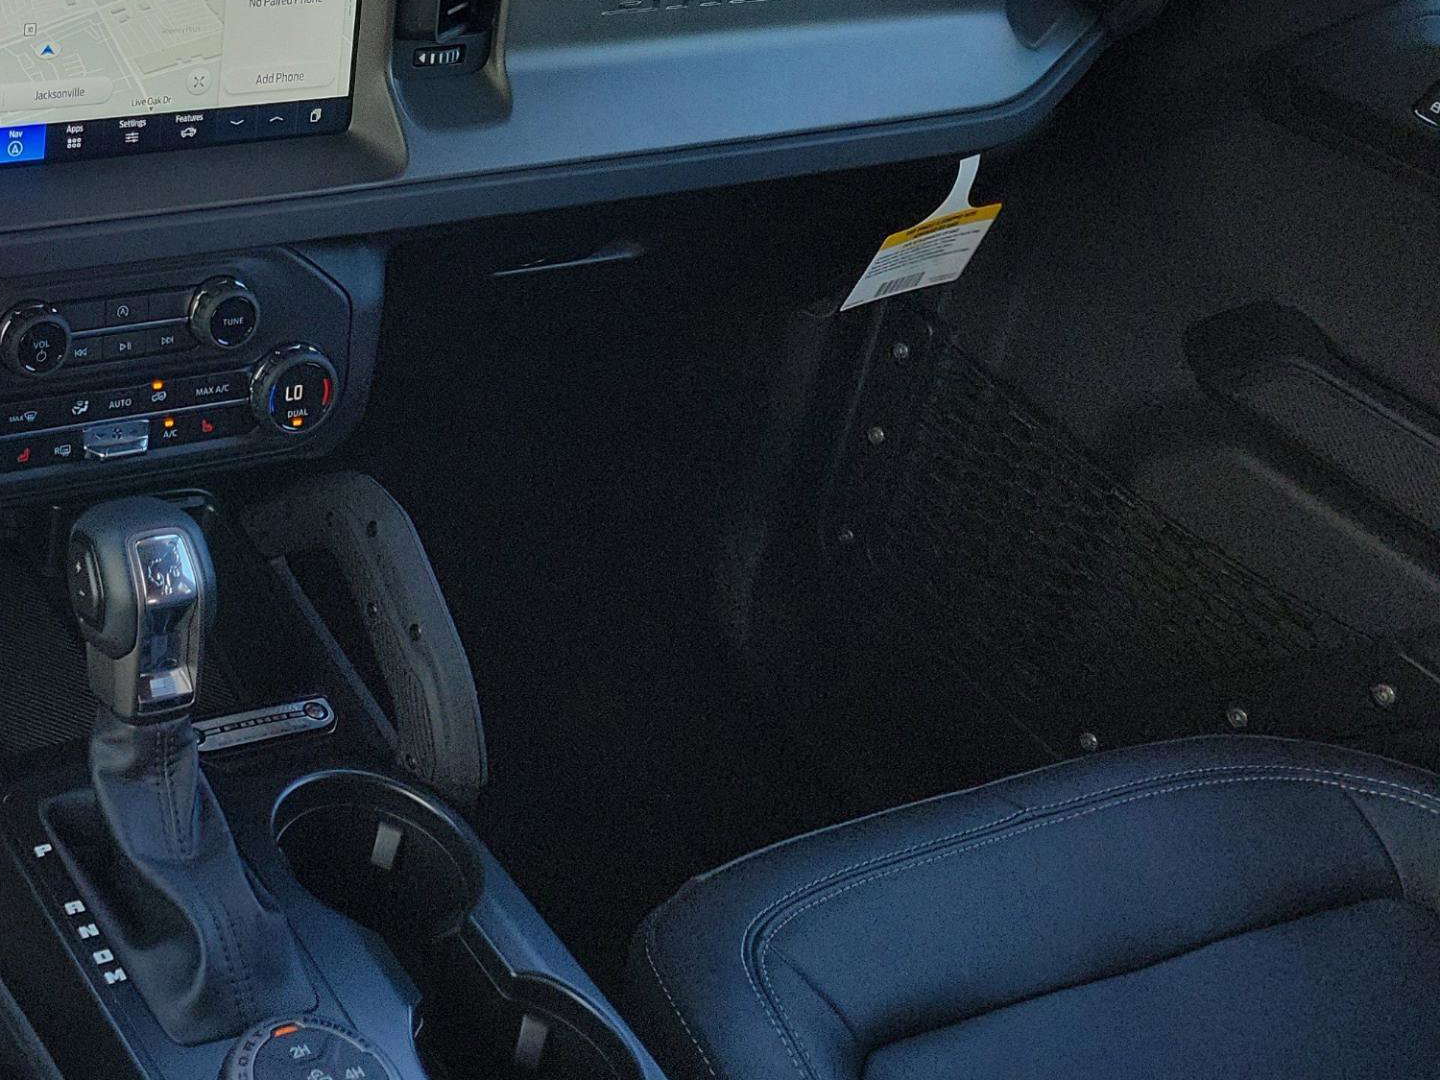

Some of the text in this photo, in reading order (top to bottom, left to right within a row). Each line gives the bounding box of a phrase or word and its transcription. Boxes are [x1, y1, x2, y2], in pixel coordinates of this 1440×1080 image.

[256, 71, 305, 85] Add Phone
[34, 88, 85, 101] Jacksonville
[131, 96, 172, 107] Live Oak Dr
[119, 119, 147, 129] Settings
[175, 114, 204, 124] Features
[9, 130, 23, 139] Nav
[66, 125, 84, 135] Apps
[223, 317, 244, 327] TUNE
[33, 341, 50, 349] VOL
[195, 384, 230, 397] MAX A/C
[285, 384, 304, 402] LO
[109, 399, 132, 409] AUTO
[287, 409, 309, 418] DUAL
[163, 428, 178, 438] A/C
[34, 843, 52, 858] P
[64, 899, 85, 915] R
[78, 923, 100, 939] N
[92, 949, 114, 964] D
[104, 968, 128, 985] M
[290, 1043, 312, 1060] 2H
[345, 1066, 366, 1080] 4H
